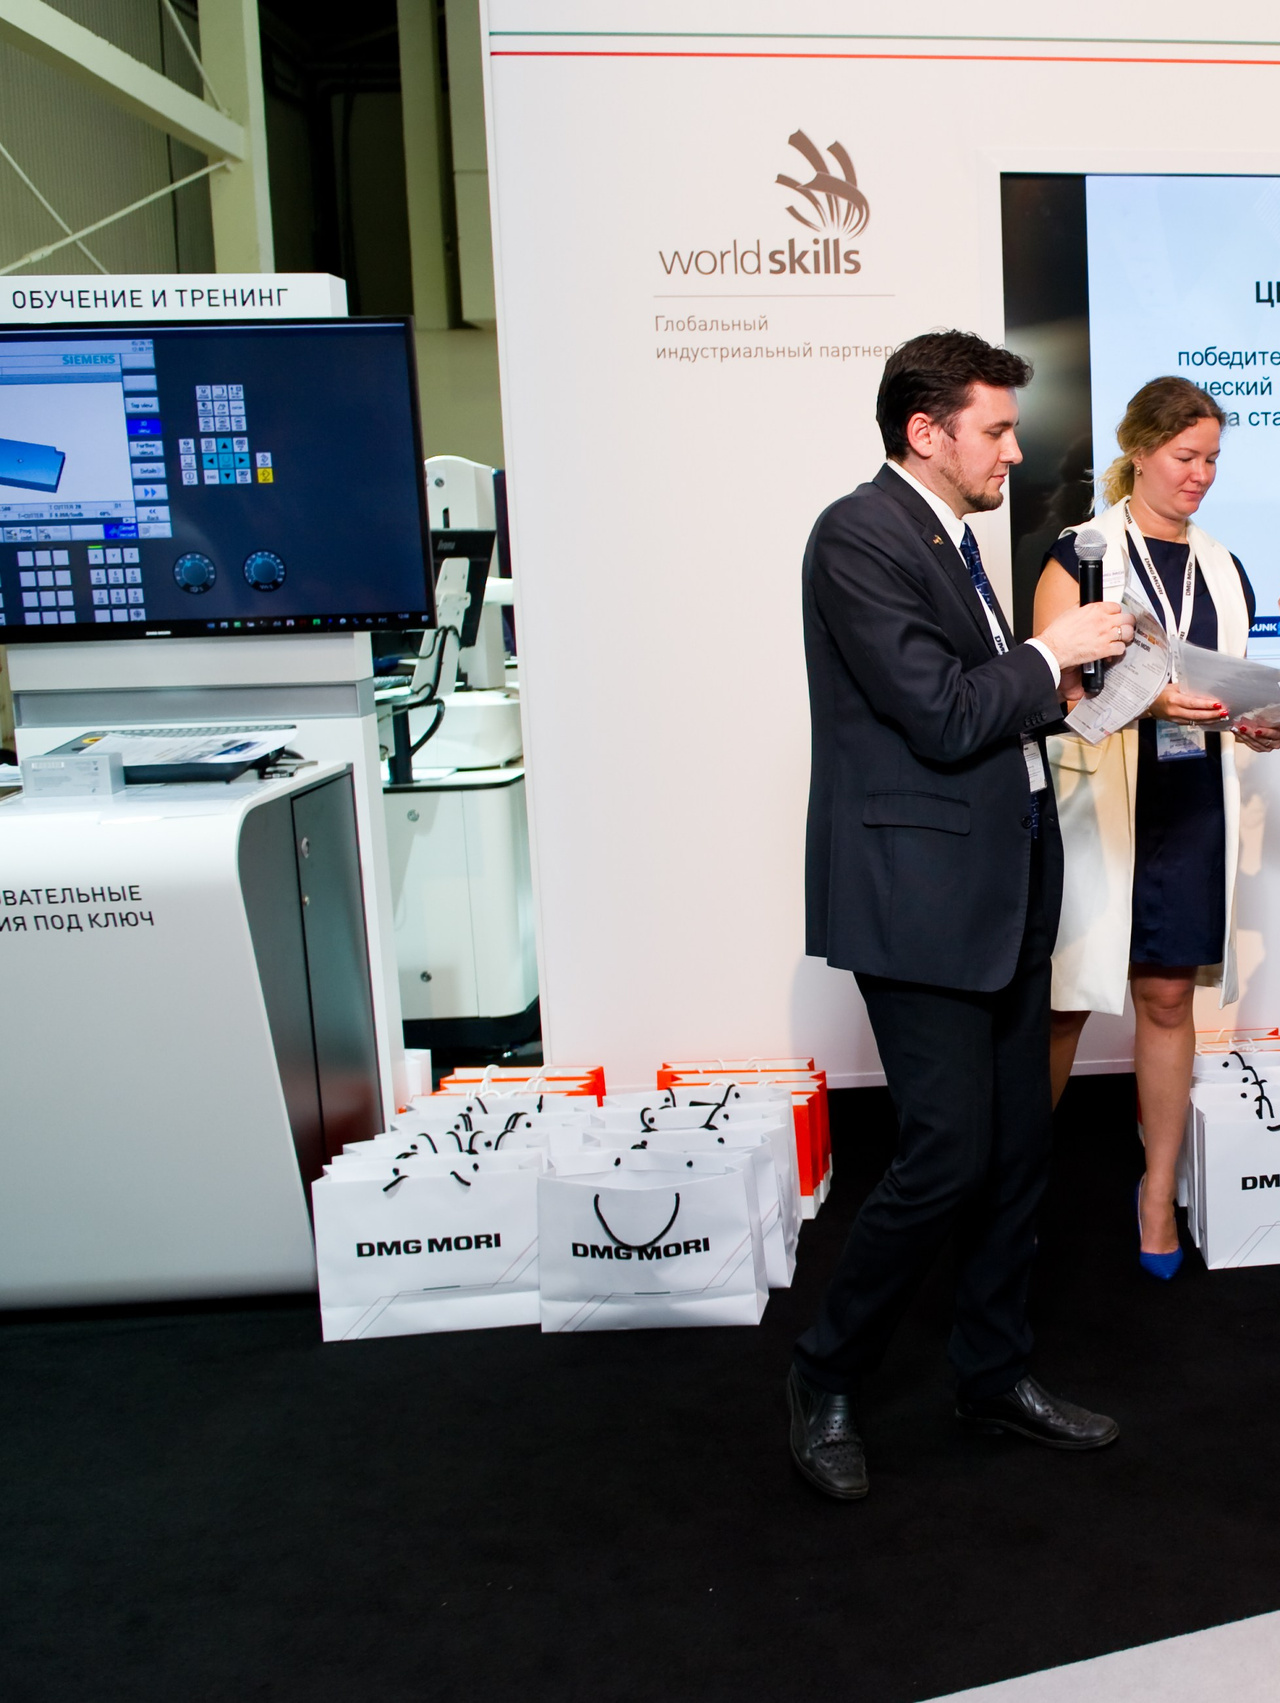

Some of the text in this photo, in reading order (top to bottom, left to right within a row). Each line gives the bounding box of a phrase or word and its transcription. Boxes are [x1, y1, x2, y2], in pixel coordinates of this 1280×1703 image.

[12, 288, 289, 309] ОБУЧЕНИЕ И ТРЕНИНГ
[655, 315, 769, 332] Глобальный
[62, 355, 116, 365] SIEMENS
[656, 342, 894, 363] индустриальный партнер
[994, 635, 1005, 654] DM
[0, 884, 143, 906] ВАТЕЛЬНЫЕ
[34, 913, 84, 933] ПОД
[88, 911, 155, 929] КЛЮЧ
[356, 1233, 502, 1258] DMG MORI
[571, 1237, 711, 1262] DMG MORI
